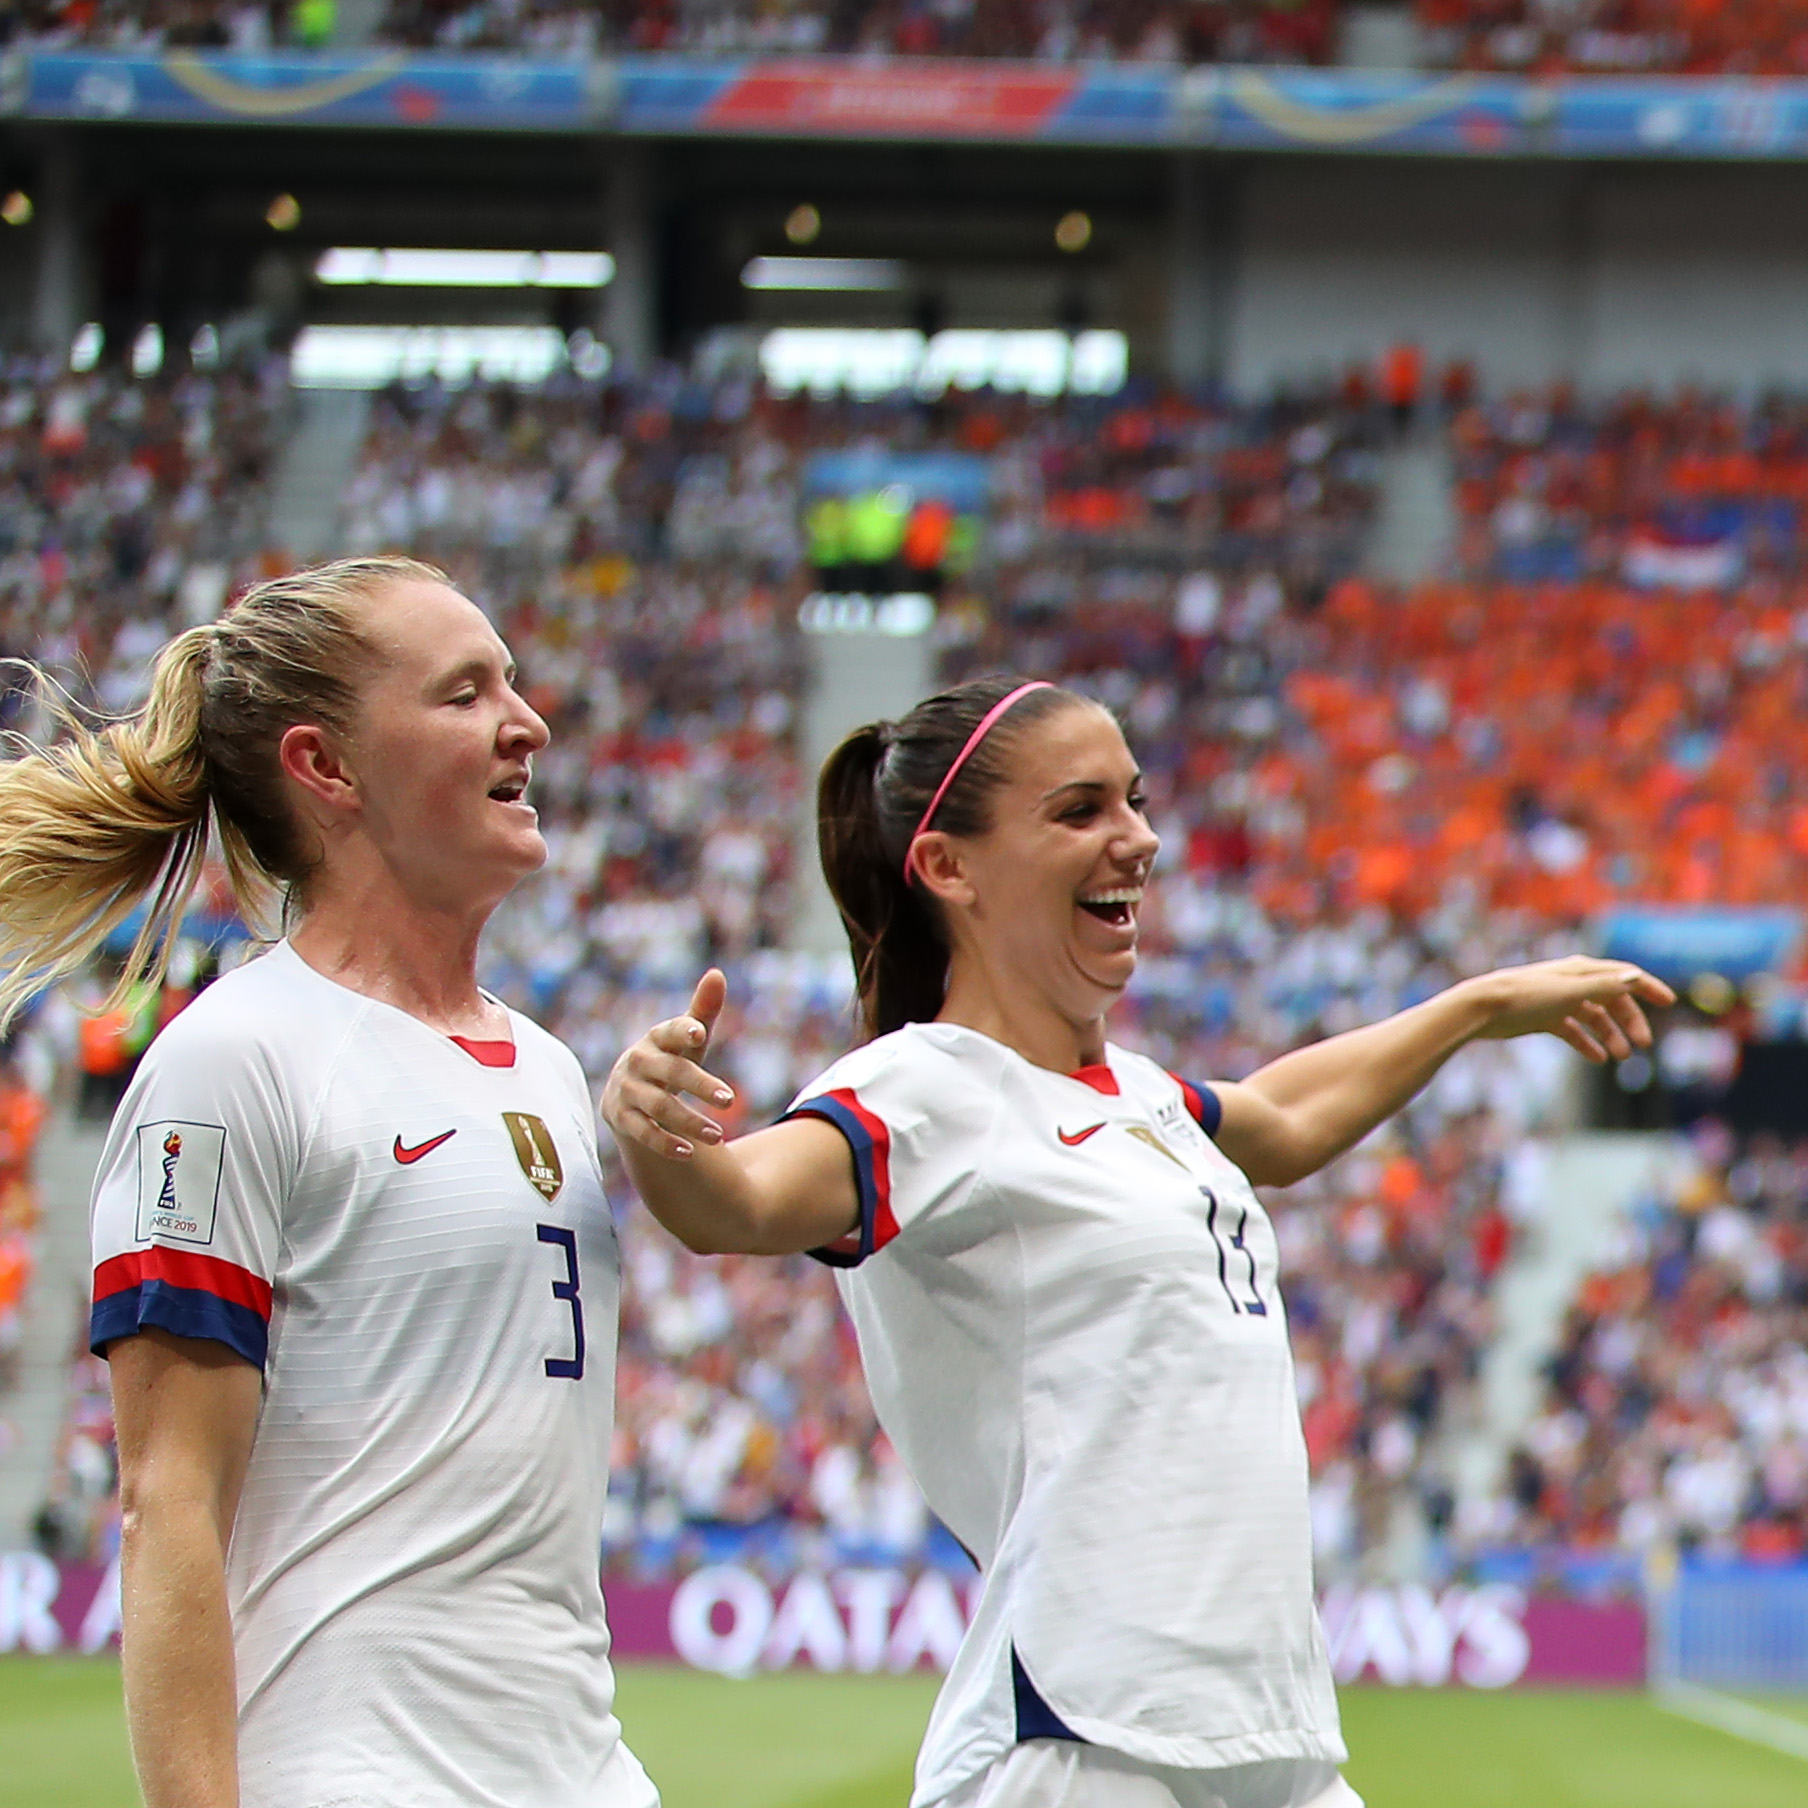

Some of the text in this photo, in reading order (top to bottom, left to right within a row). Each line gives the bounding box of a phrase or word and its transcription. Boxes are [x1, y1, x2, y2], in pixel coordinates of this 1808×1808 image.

[174, 1219, 197, 1233] 2019
[1198, 1185, 1268, 1317] 13
[536, 1223, 586, 1381] 3
[669, 1563, 987, 1680] QATA
